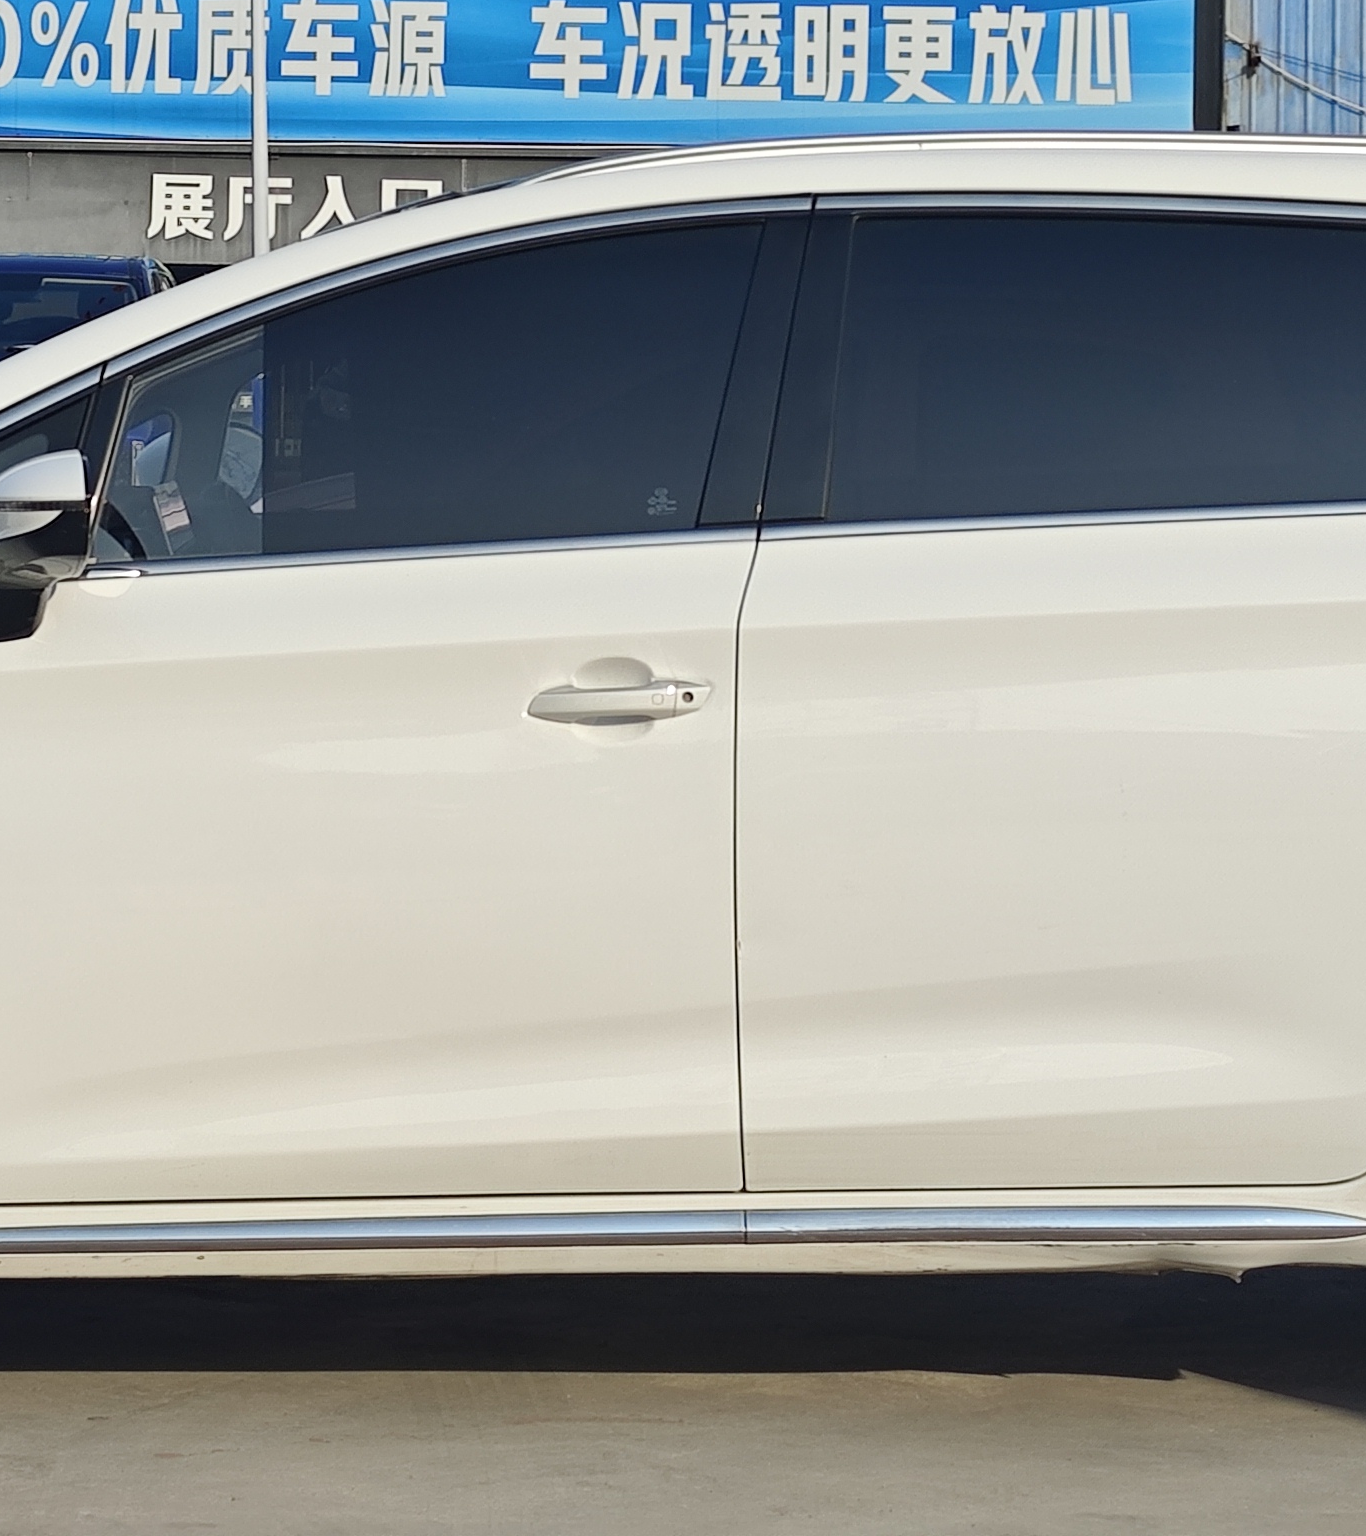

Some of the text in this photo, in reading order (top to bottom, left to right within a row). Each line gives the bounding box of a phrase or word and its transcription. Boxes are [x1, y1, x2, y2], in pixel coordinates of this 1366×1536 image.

[528, 0, 1133, 106] 车况透明更放心
